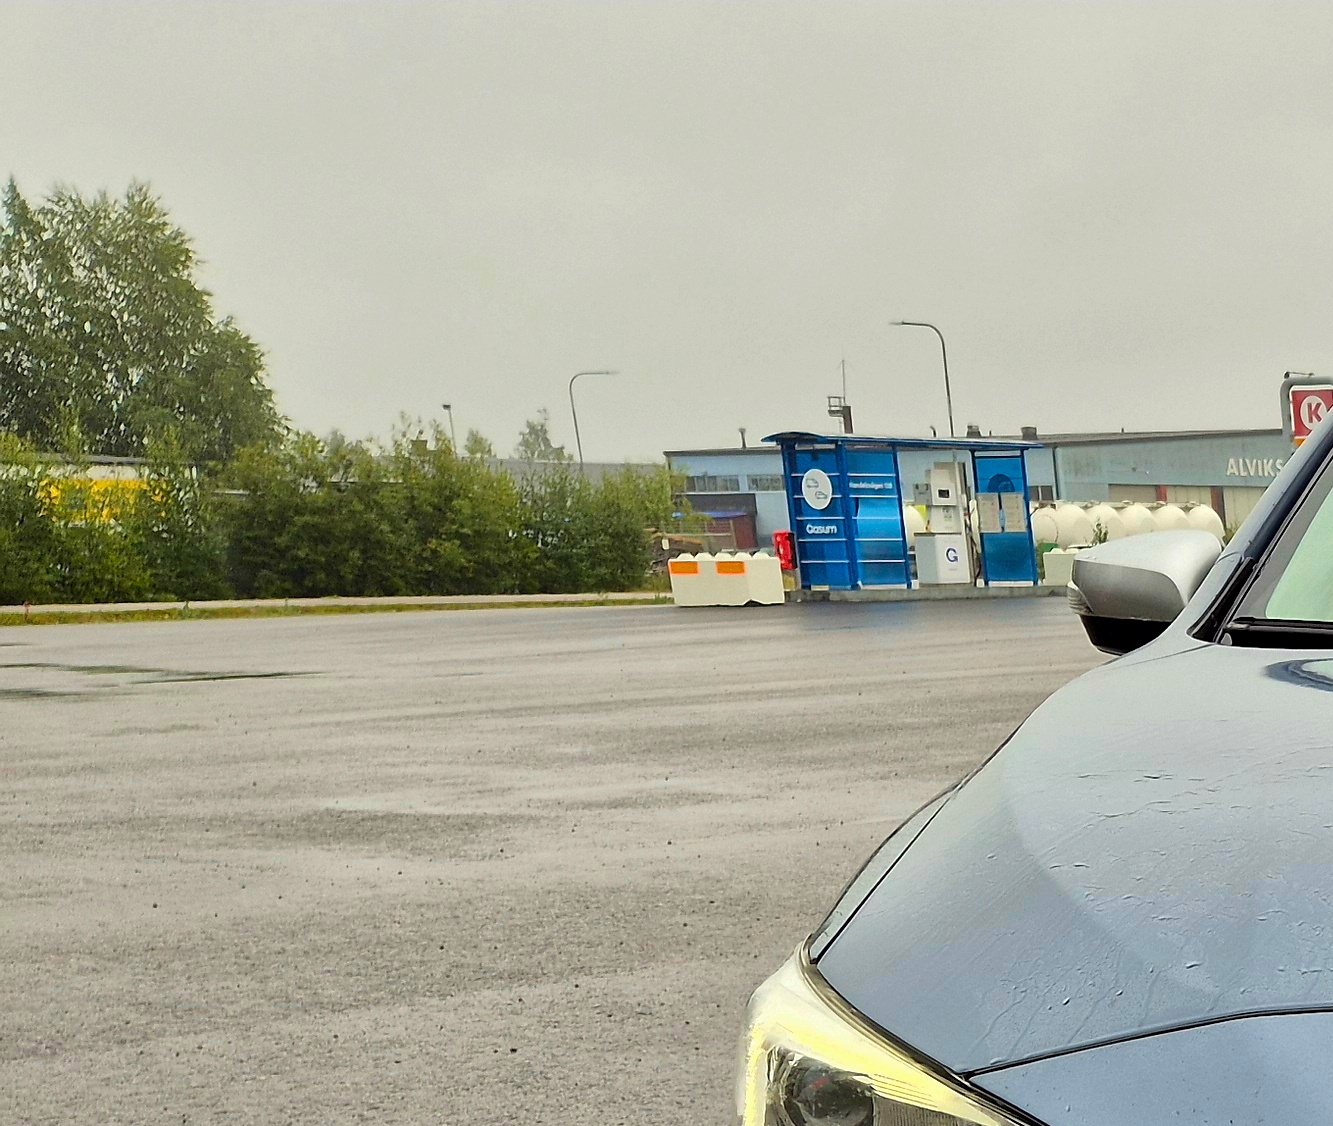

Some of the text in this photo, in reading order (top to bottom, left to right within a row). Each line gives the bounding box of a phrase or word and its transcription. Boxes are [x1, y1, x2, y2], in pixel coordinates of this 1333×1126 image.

[1307, 402, 1322, 423] K
[806, 524, 837, 534] Gasum
[946, 548, 958, 562] G
